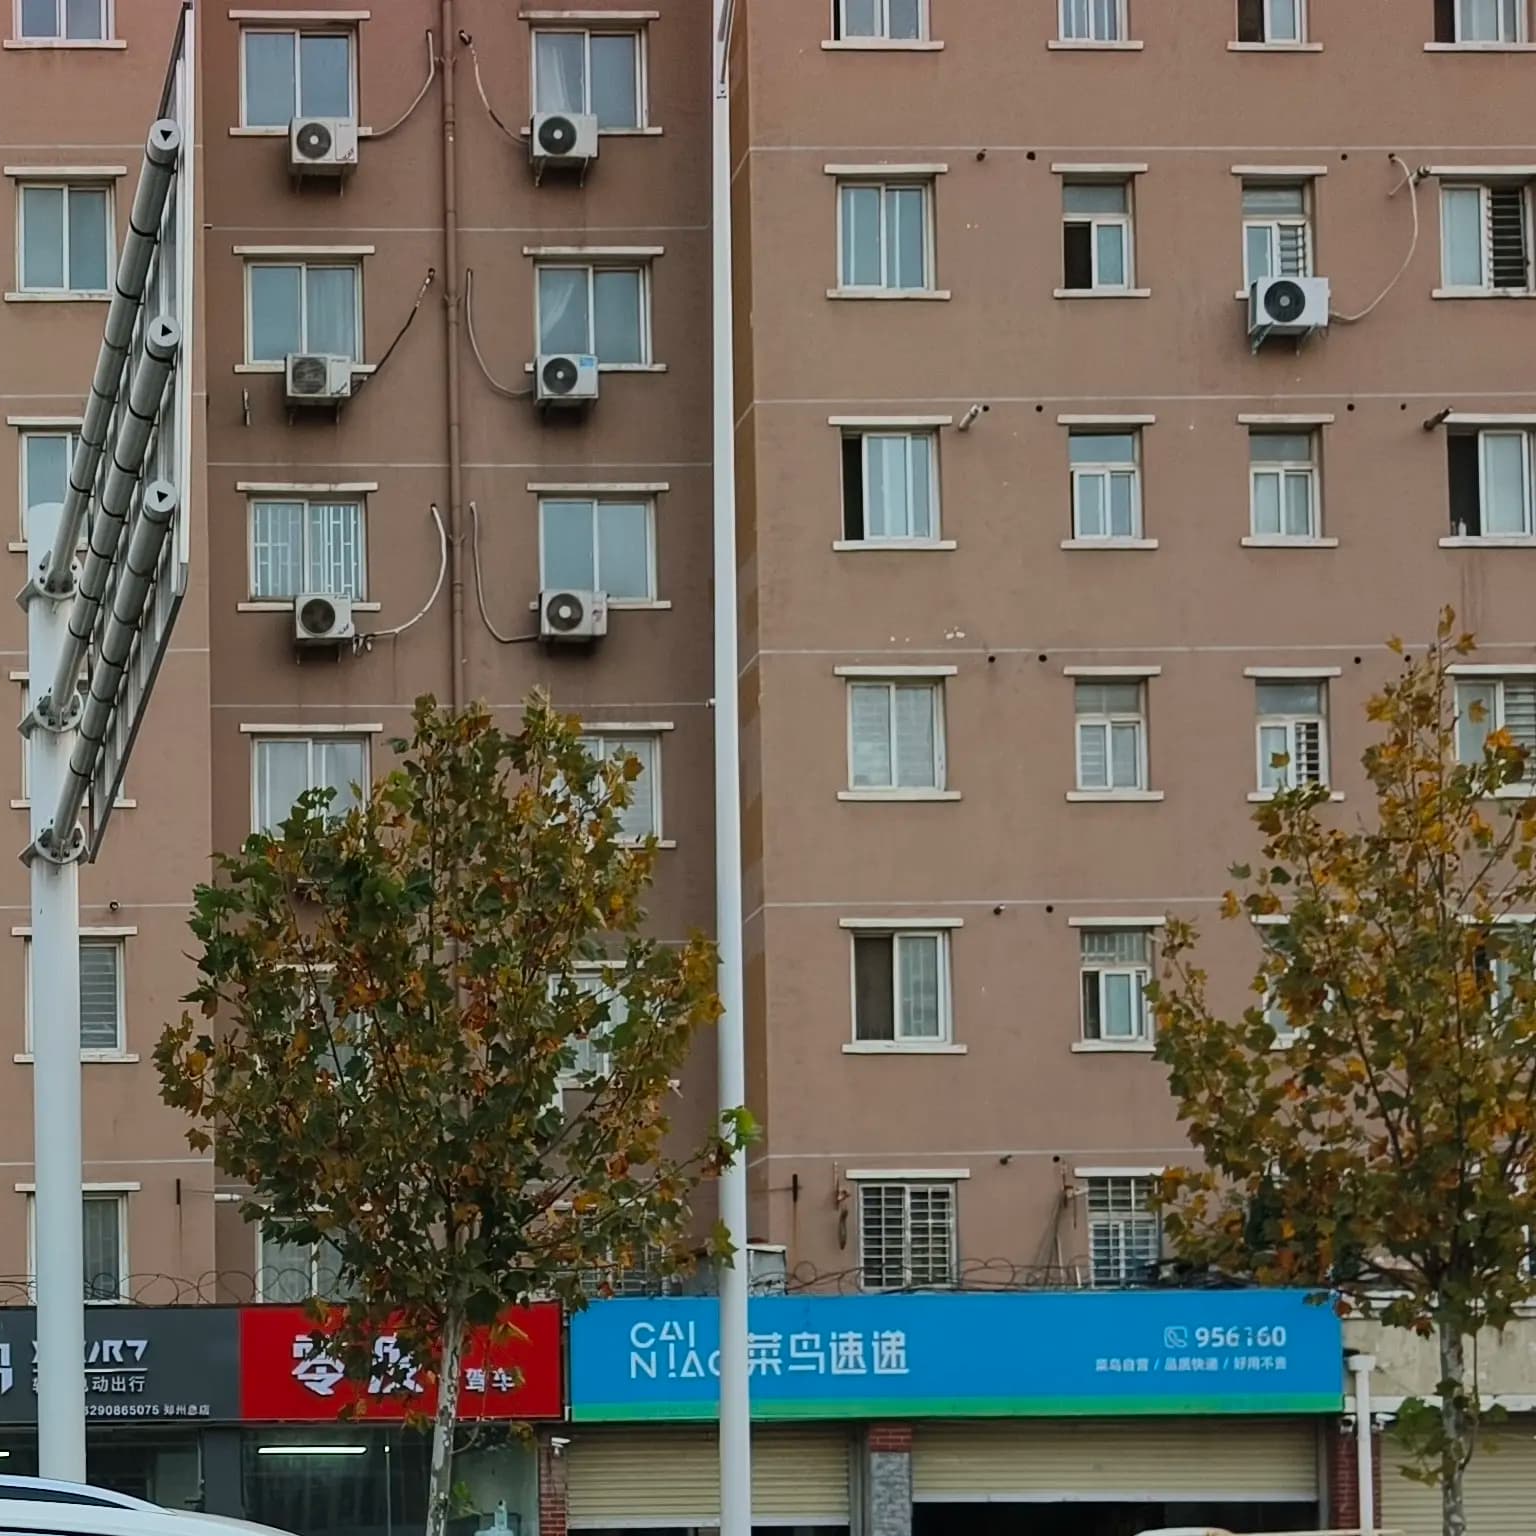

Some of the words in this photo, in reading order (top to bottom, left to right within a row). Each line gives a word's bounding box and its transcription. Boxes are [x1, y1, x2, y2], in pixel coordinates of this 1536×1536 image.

[630, 1320, 695, 1348] CAI
[748, 1330, 910, 1376] 菜鸟速递
